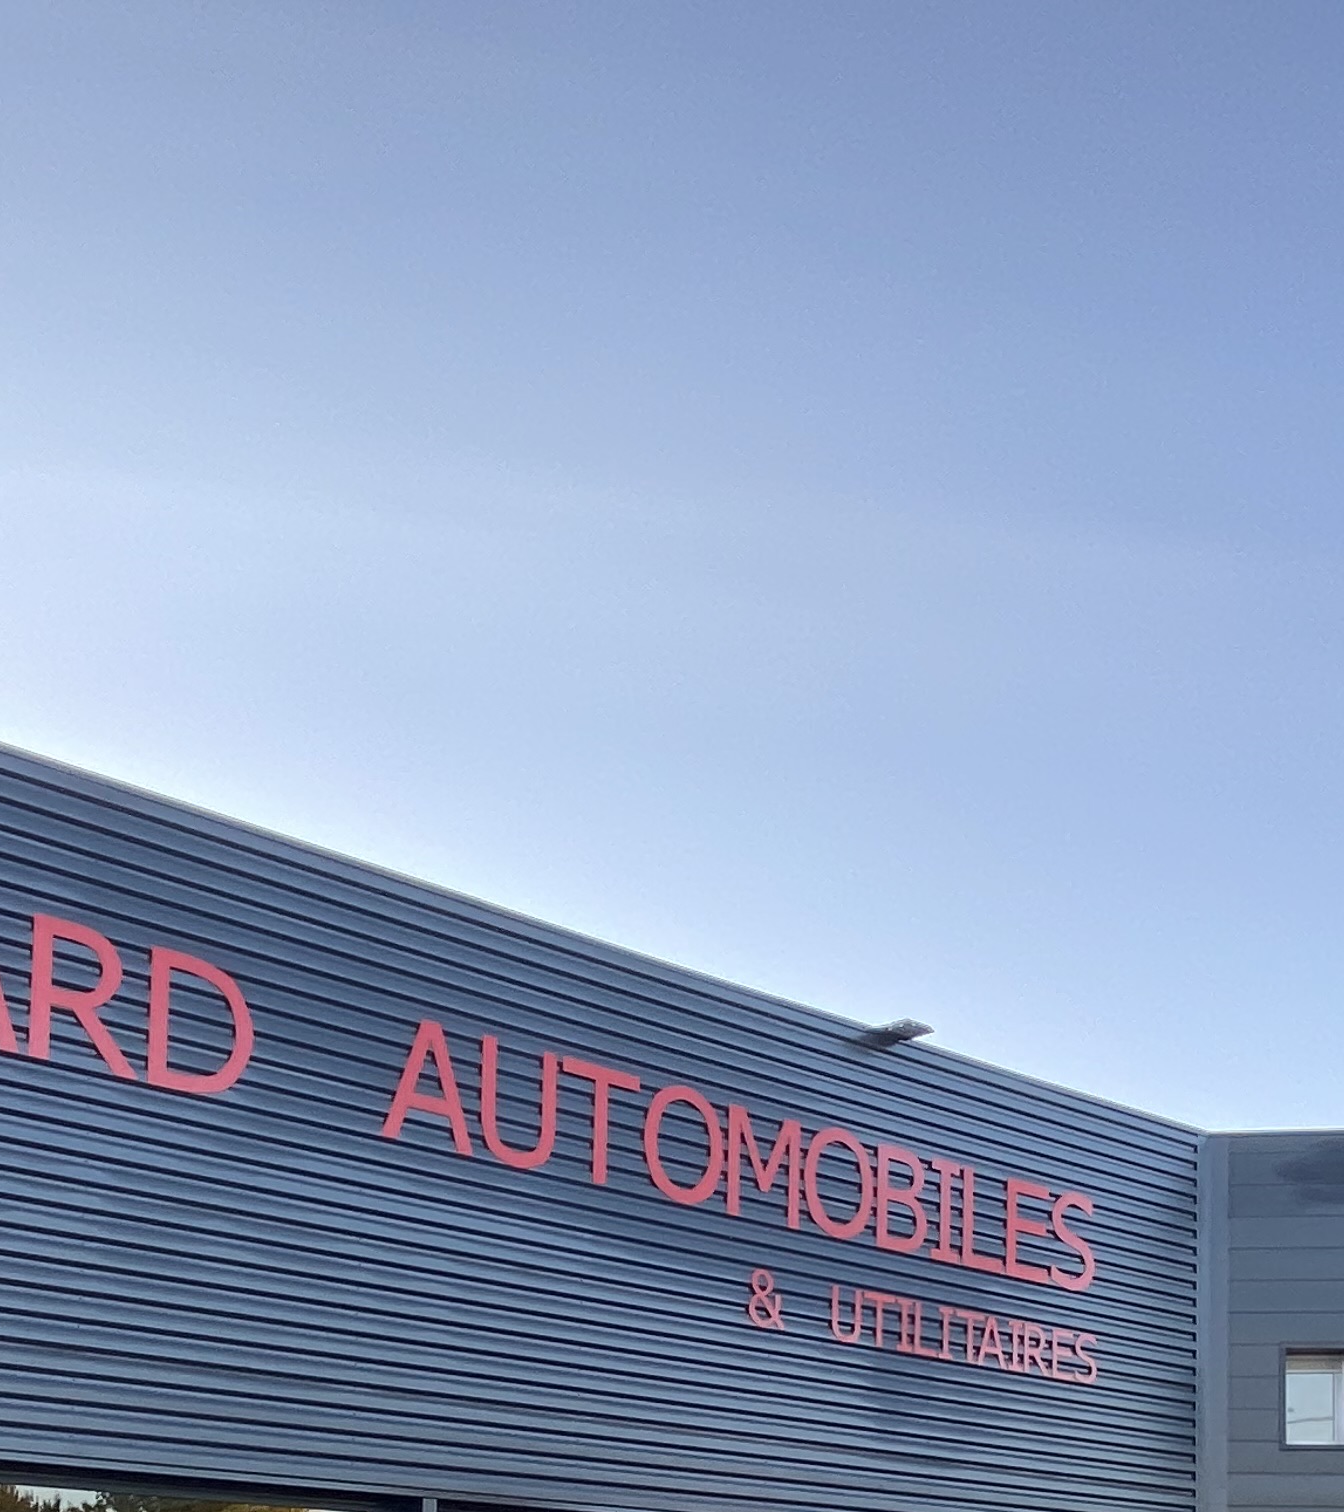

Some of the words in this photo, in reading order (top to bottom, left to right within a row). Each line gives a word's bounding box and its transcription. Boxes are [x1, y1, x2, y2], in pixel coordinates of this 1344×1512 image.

[381, 1019, 1095, 1292] AUTOMOBILES
[748, 1268, 784, 1331] &
[831, 1285, 1098, 1384] UTILITAIRES
